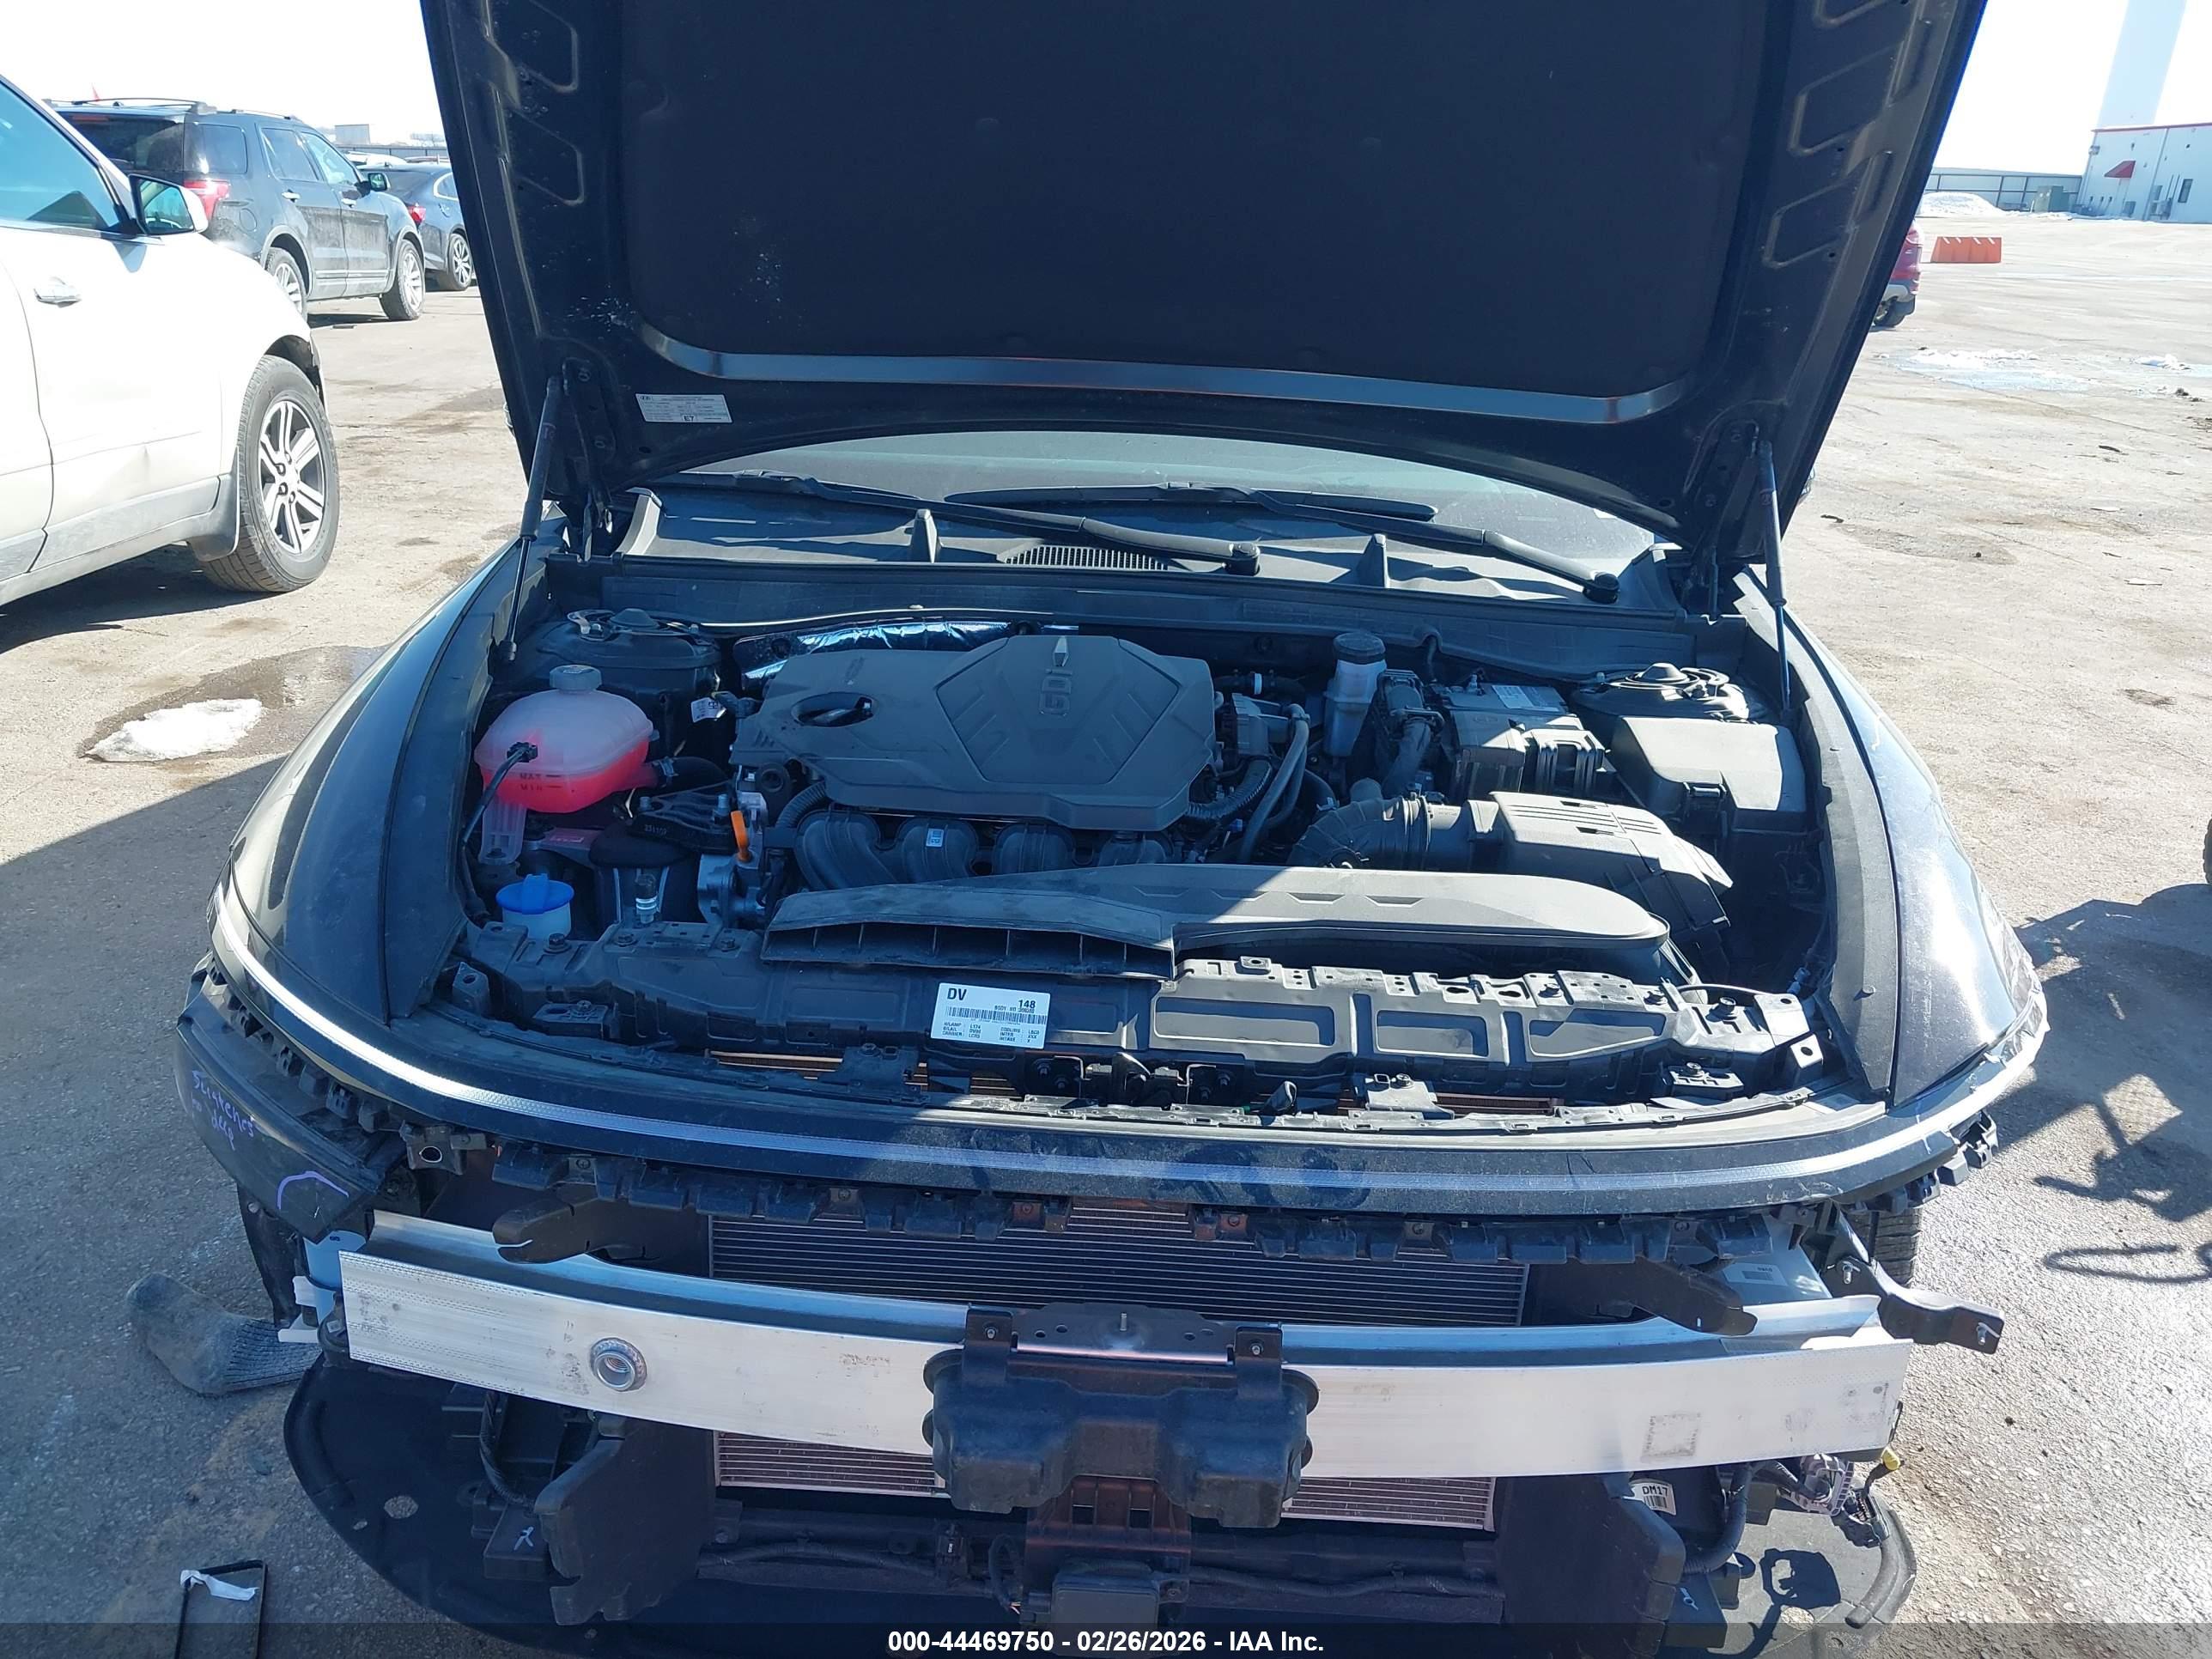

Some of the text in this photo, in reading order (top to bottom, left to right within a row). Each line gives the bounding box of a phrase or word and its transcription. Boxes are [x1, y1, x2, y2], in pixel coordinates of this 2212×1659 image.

[947, 988, 967, 1000] DV
[1018, 1000, 1036, 1009] 148
[1641, 1485, 1668, 1497] DM17
